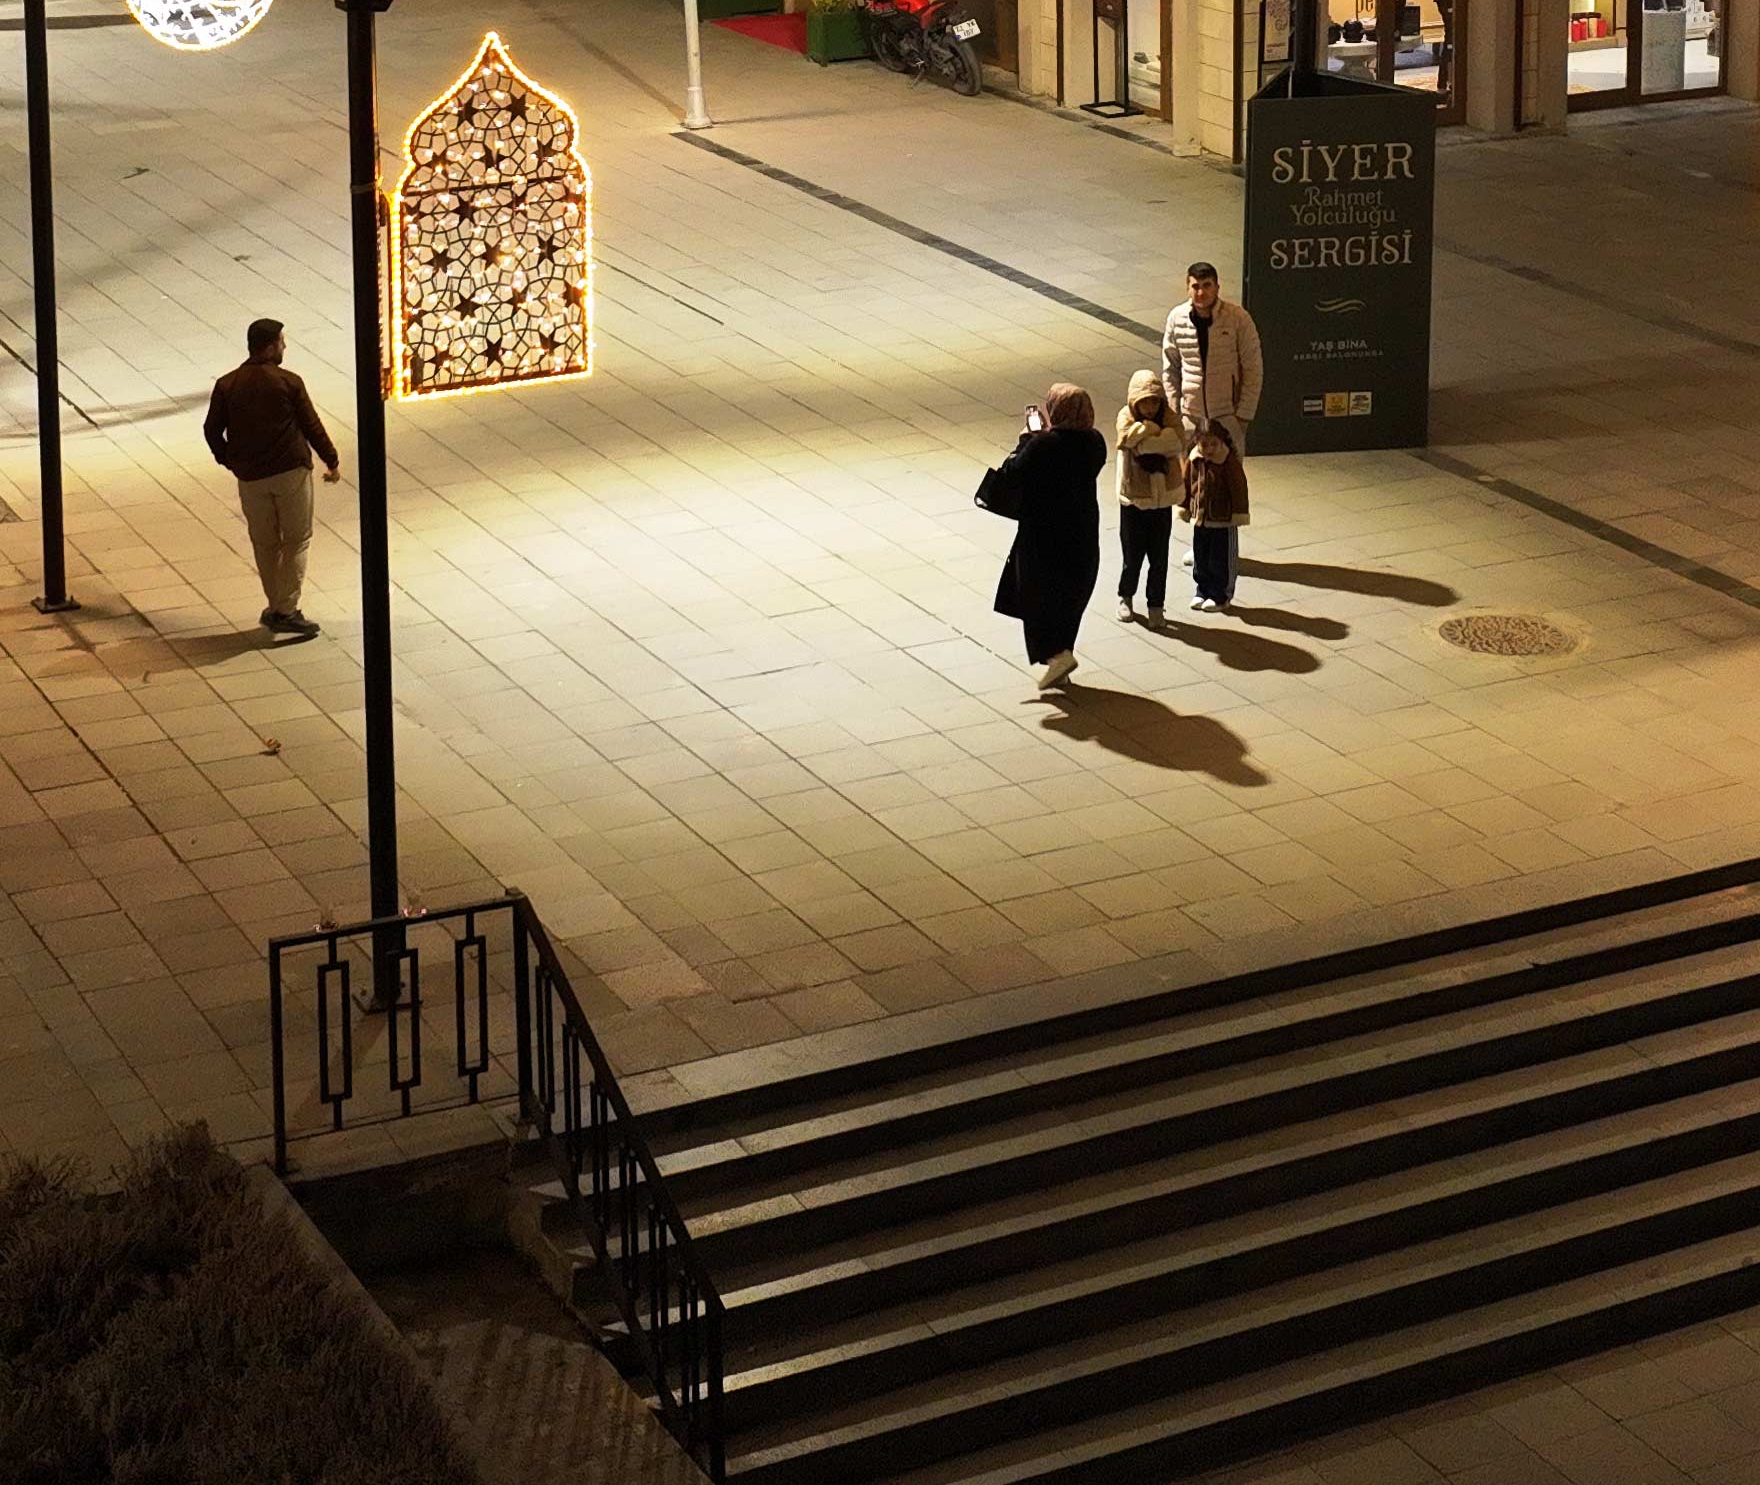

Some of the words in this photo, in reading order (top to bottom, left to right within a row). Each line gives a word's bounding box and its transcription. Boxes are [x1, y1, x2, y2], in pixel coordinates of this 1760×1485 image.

[1271, 140, 1415, 183] SİYER
[1304, 186, 1384, 210] Rahmet
[1290, 203, 1397, 228] Yolculuğu
[1270, 229, 1413, 270] SERGİSİ
[1310, 340, 1334, 352] TAŞ
[1337, 338, 1368, 351] BİNA
